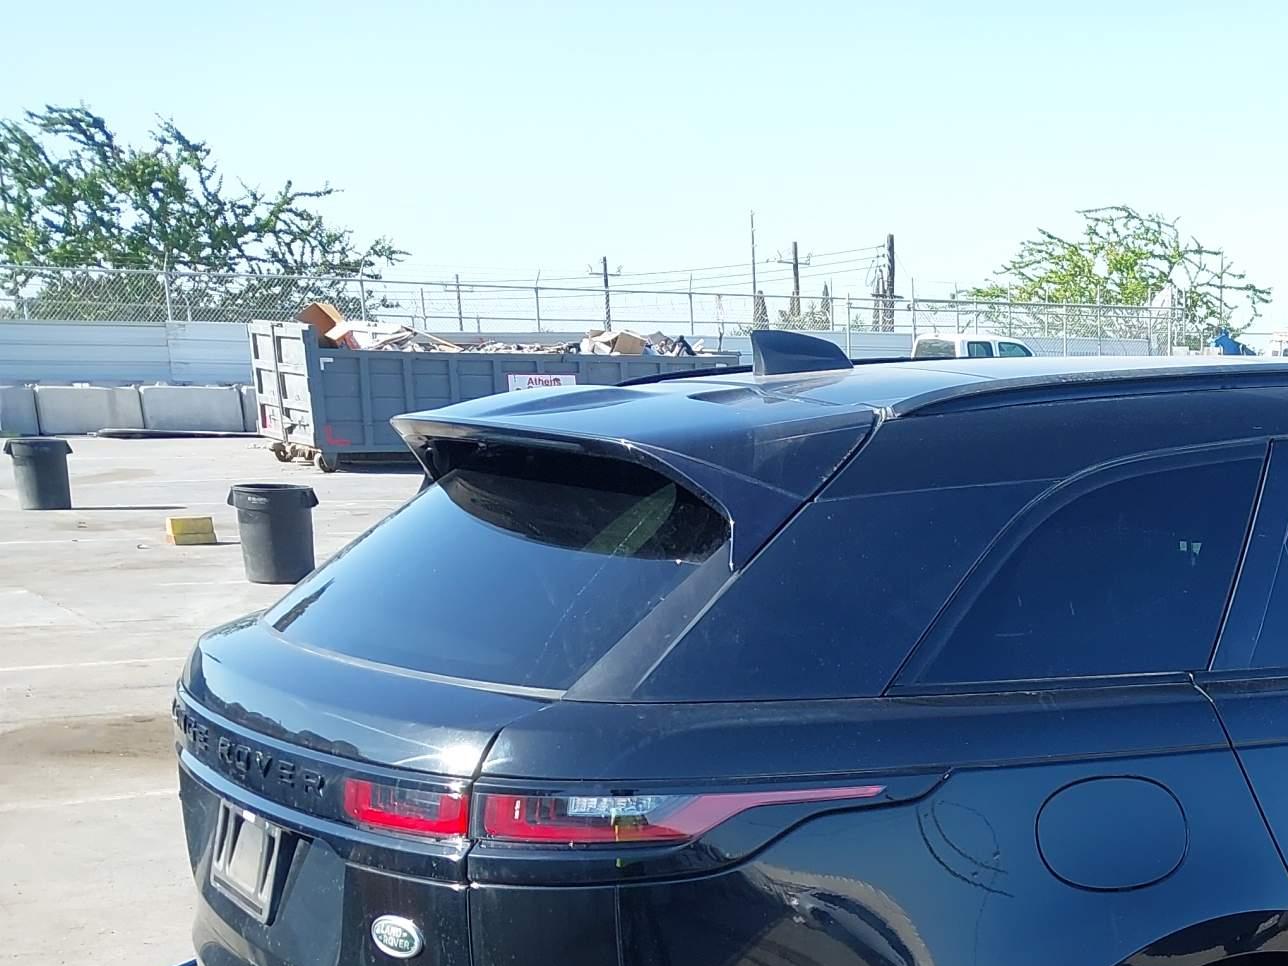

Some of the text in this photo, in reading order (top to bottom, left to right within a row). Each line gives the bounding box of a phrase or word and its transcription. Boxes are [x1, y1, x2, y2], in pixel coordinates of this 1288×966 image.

[218, 735, 326, 799] ROVER
[380, 922, 402, 938] LAND
[382, 934, 411, 951] ROVER
